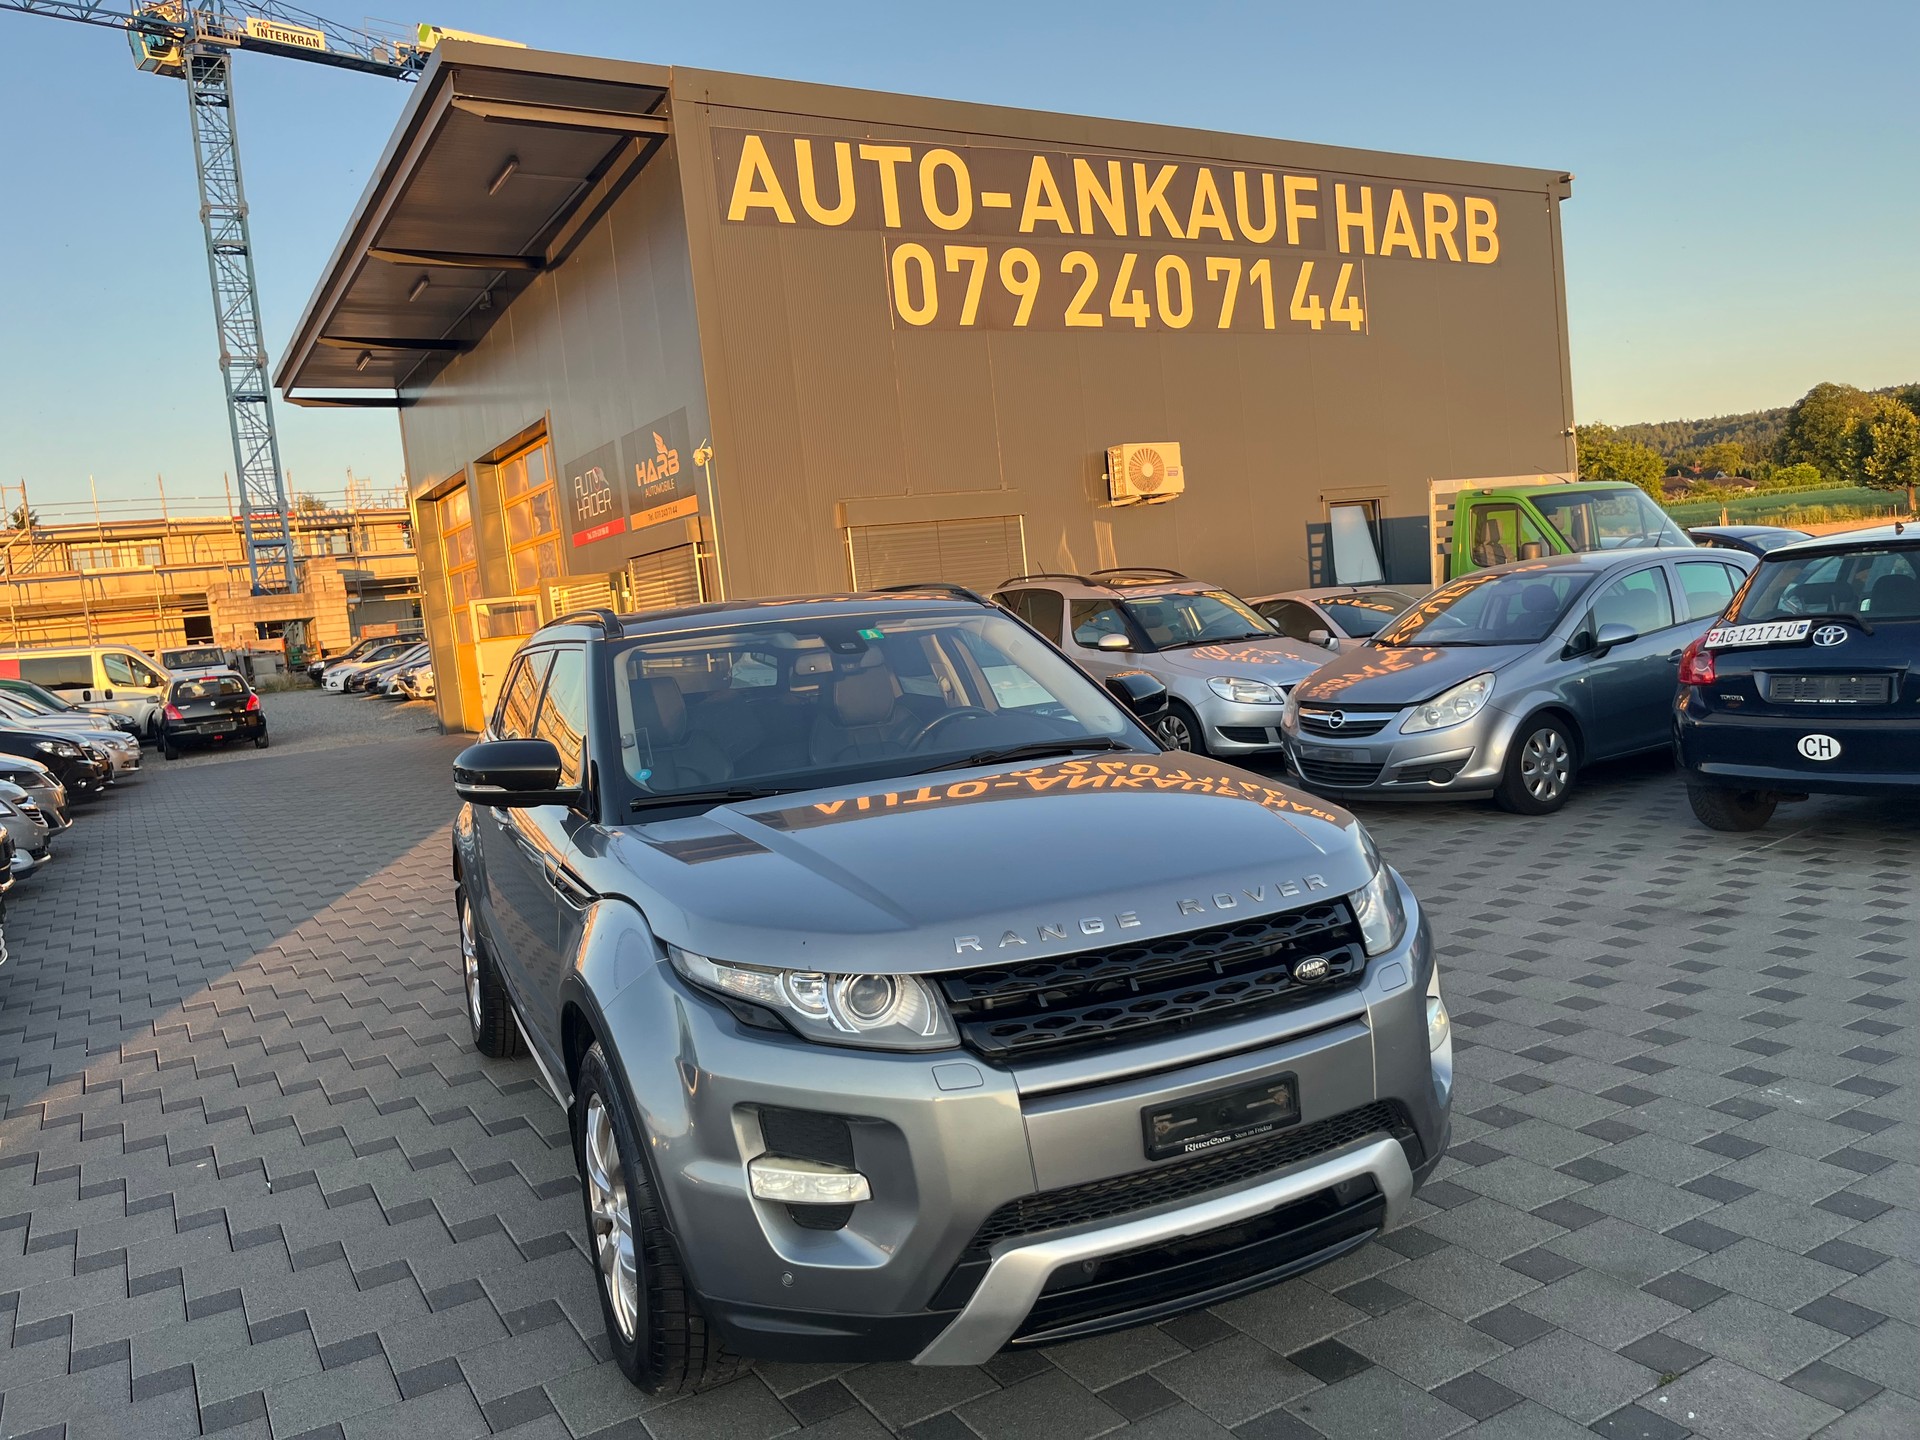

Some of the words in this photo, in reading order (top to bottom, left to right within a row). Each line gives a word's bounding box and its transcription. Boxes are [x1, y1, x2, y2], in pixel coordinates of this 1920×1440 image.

[256, 27, 320, 48] INTERKRAN
[727, 134, 1318, 245] AUTO-ANKAUF
[1334, 182, 1500, 265] HARB
[891, 242, 1041, 327] 079
[1060, 250, 1194, 329] 240
[635, 448, 680, 487] HARB
[576, 487, 612, 522] HAIDER
[1803, 737, 1832, 758] CH
[953, 909, 1143, 954] RANGE
[1176, 873, 1329, 916] ROVER
[1302, 961, 1320, 973] LAND
